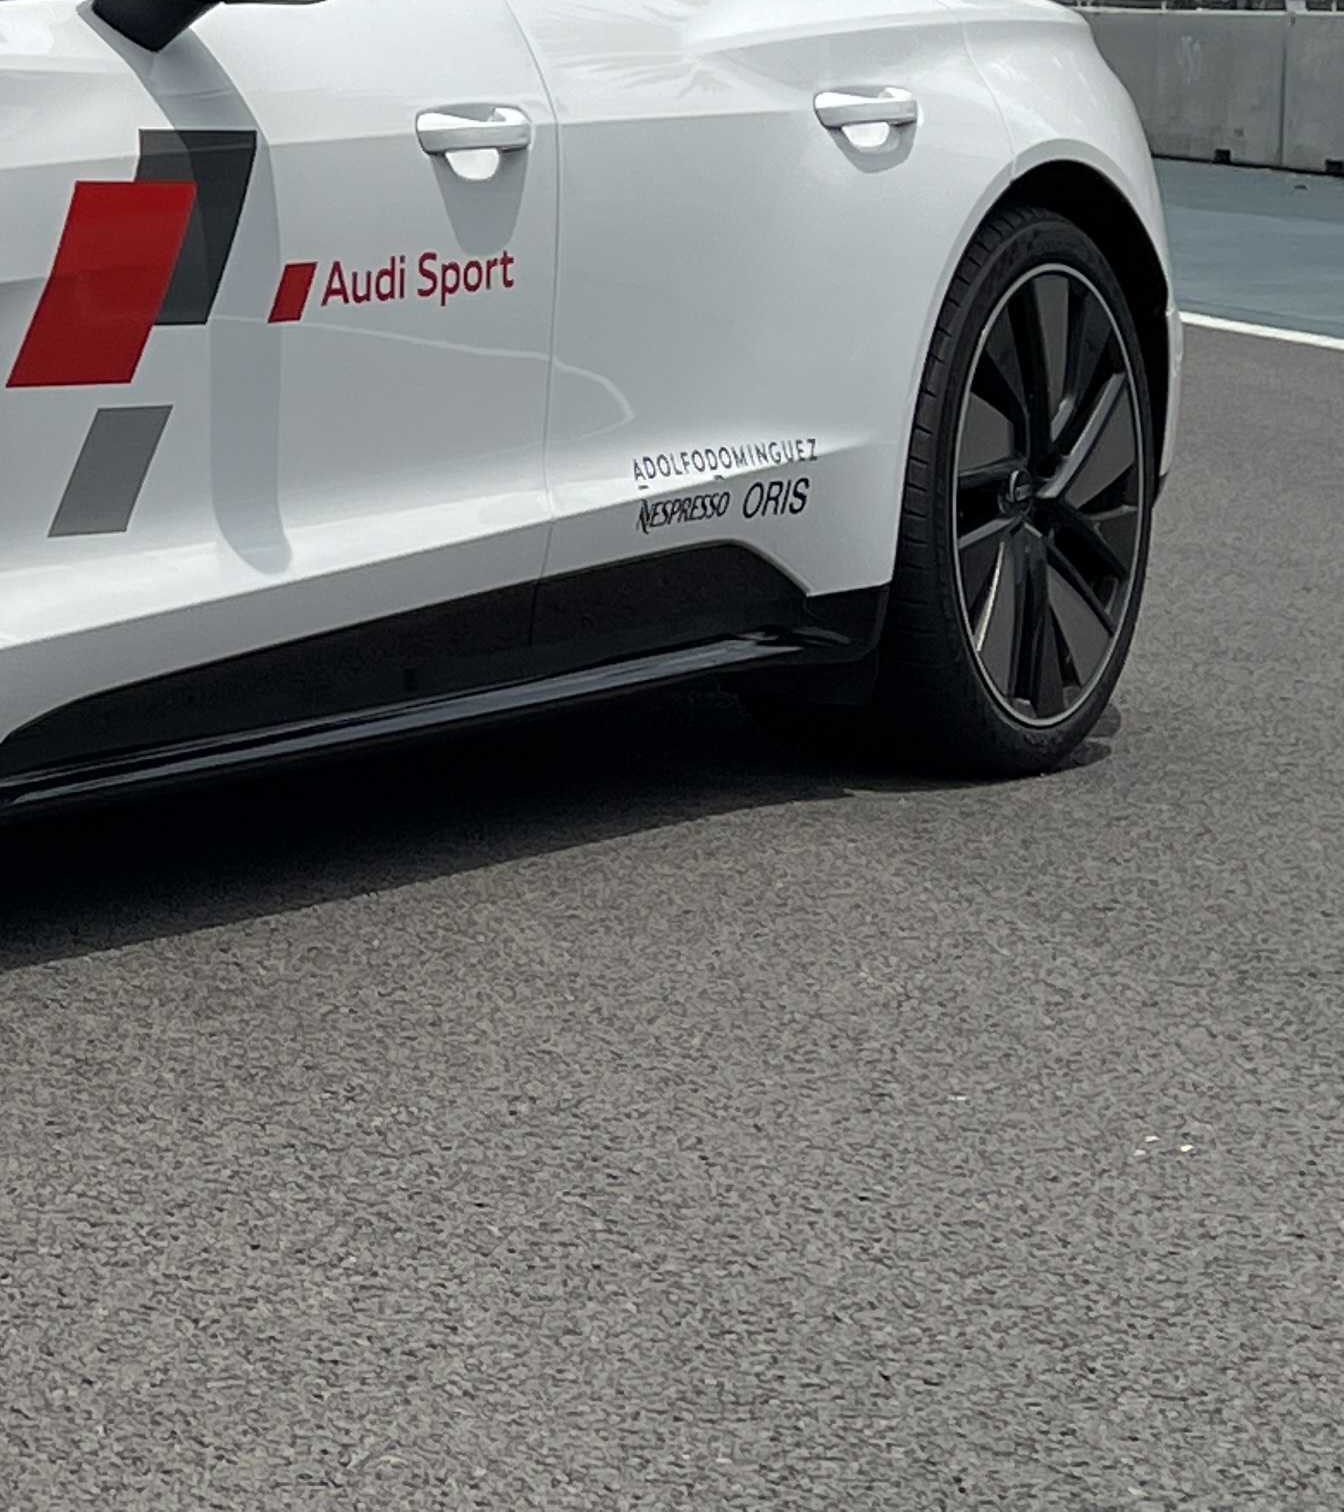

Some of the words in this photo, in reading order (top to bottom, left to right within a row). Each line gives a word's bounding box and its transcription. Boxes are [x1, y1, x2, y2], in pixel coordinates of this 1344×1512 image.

[320, 254, 407, 307] Audi
[416, 249, 515, 307] Sport
[635, 491, 731, 535] NESPRESSO
[742, 477, 811, 520] ORIS
